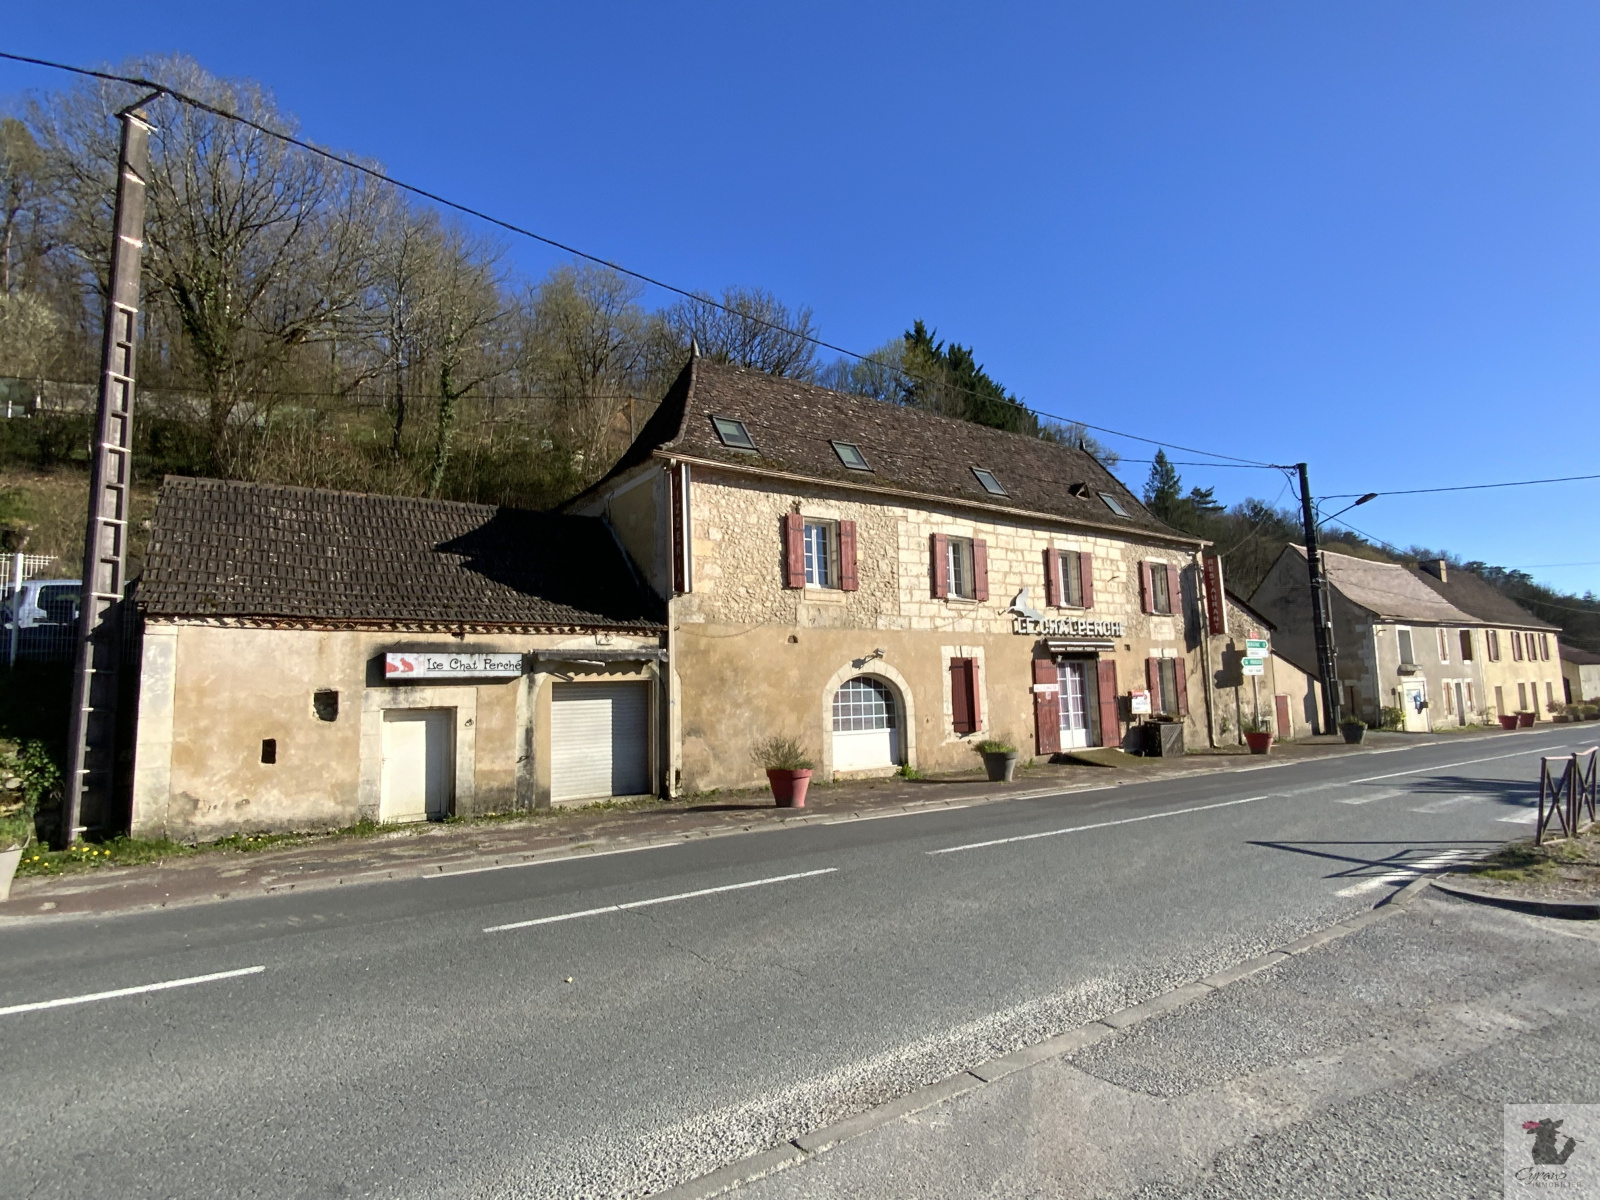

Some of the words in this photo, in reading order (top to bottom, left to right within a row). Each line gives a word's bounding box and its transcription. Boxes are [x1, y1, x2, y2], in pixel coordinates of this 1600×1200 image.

[674, 476, 682, 582] PIZZERIA
[1207, 558, 1220, 630] RESTAURANT
[1018, 617, 1038, 633] LE
[427, 658, 444, 670] Le
[450, 658, 478, 672] Chat
[484, 659, 522, 672] Perché
